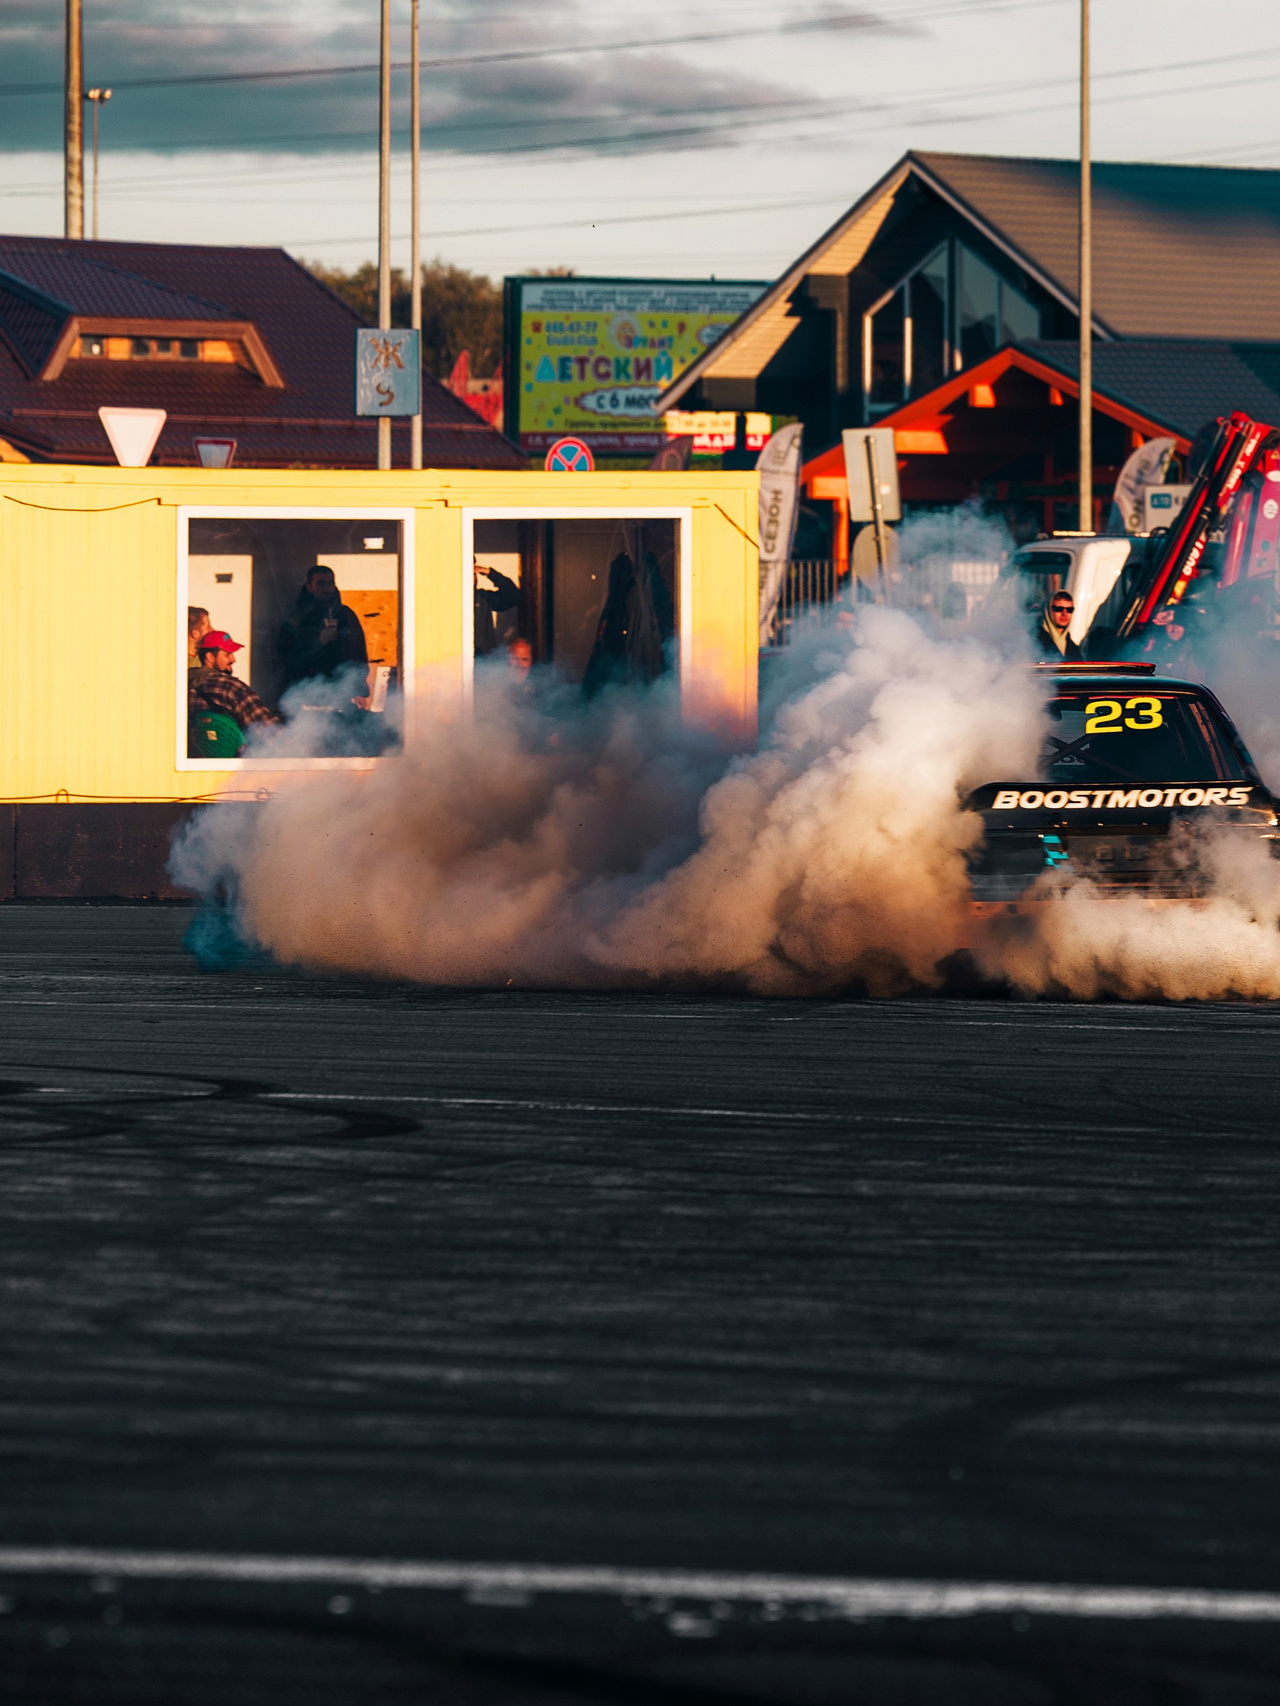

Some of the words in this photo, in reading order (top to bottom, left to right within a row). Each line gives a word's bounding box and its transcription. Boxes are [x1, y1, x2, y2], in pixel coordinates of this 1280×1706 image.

[369, 337, 405, 370] Ж
[535, 349, 674, 383] ДЕТСКИЙ
[609, 391, 620, 409] 6
[764, 488, 782, 554] СЕЗОН
[1085, 697, 1163, 734] 23
[991, 786, 1254, 810] BOOSTMOTORS
